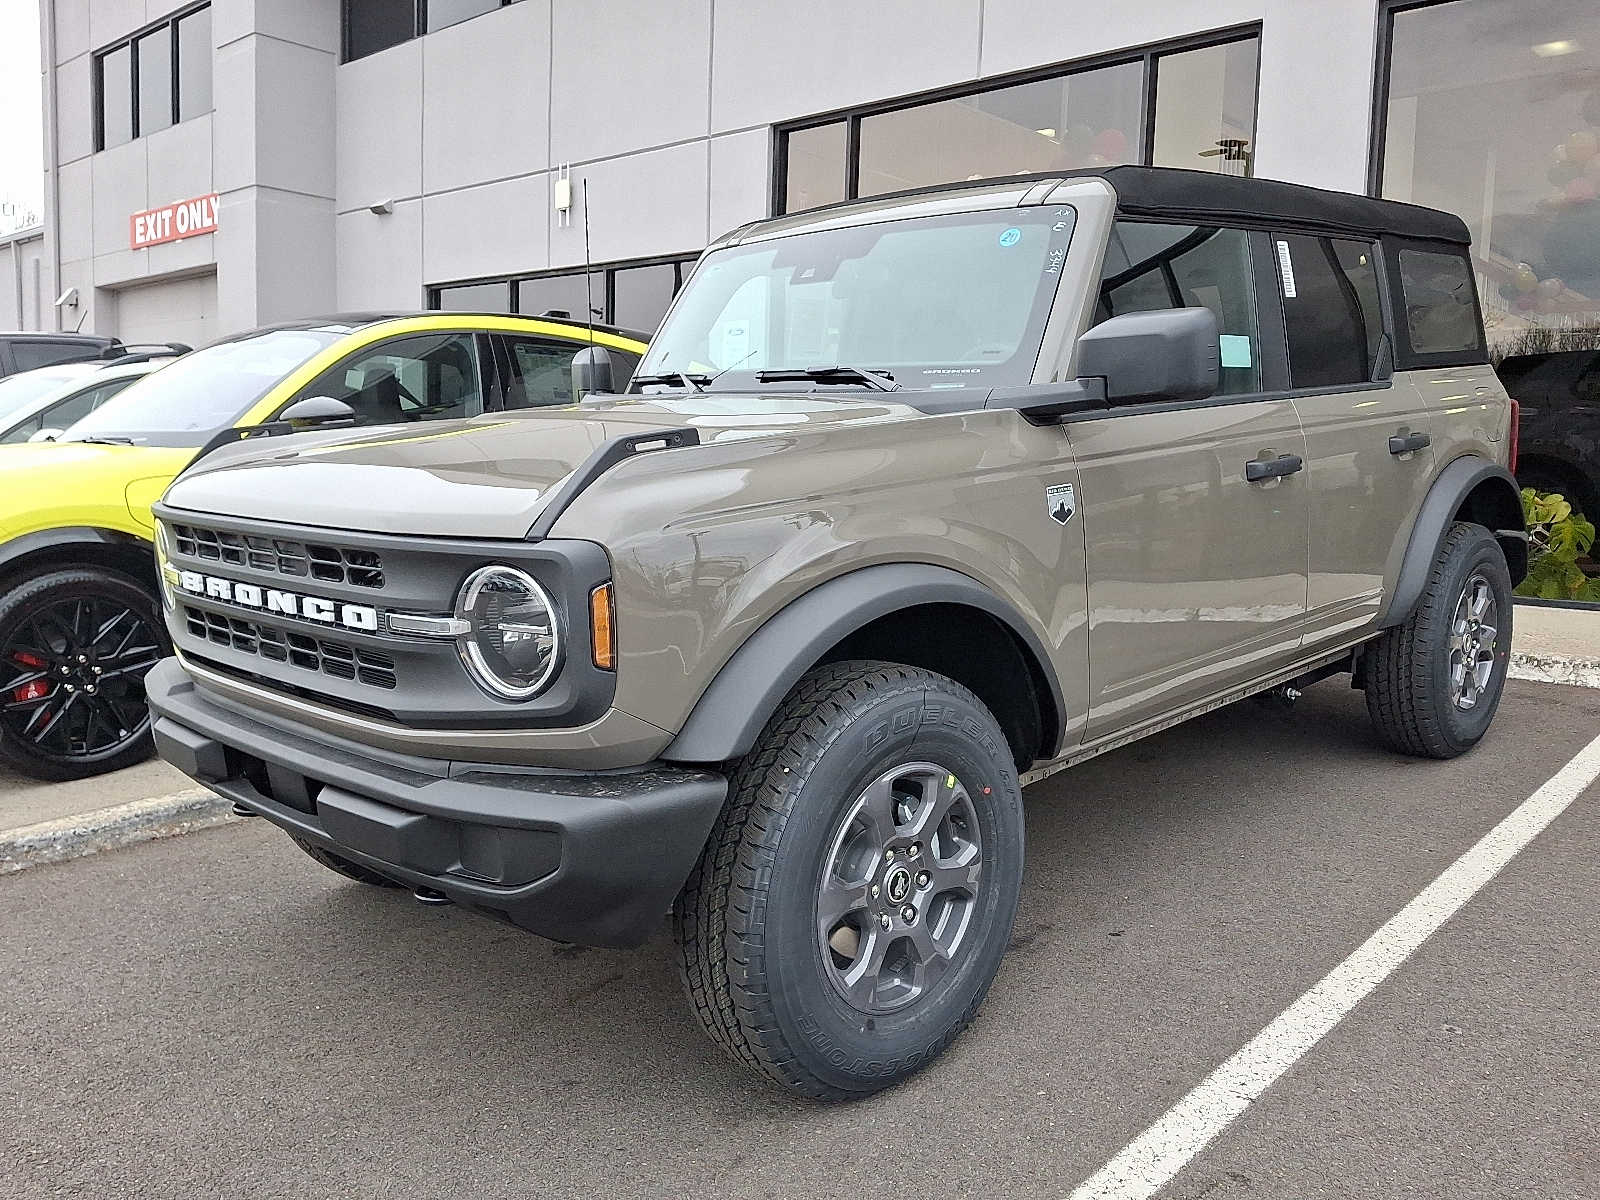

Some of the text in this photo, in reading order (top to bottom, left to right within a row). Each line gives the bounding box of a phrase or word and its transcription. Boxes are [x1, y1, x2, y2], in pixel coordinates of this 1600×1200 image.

[135, 196, 220, 244] EXIT ONLY
[181, 570, 378, 631] BRONCO
[864, 704, 999, 759] DUELER
